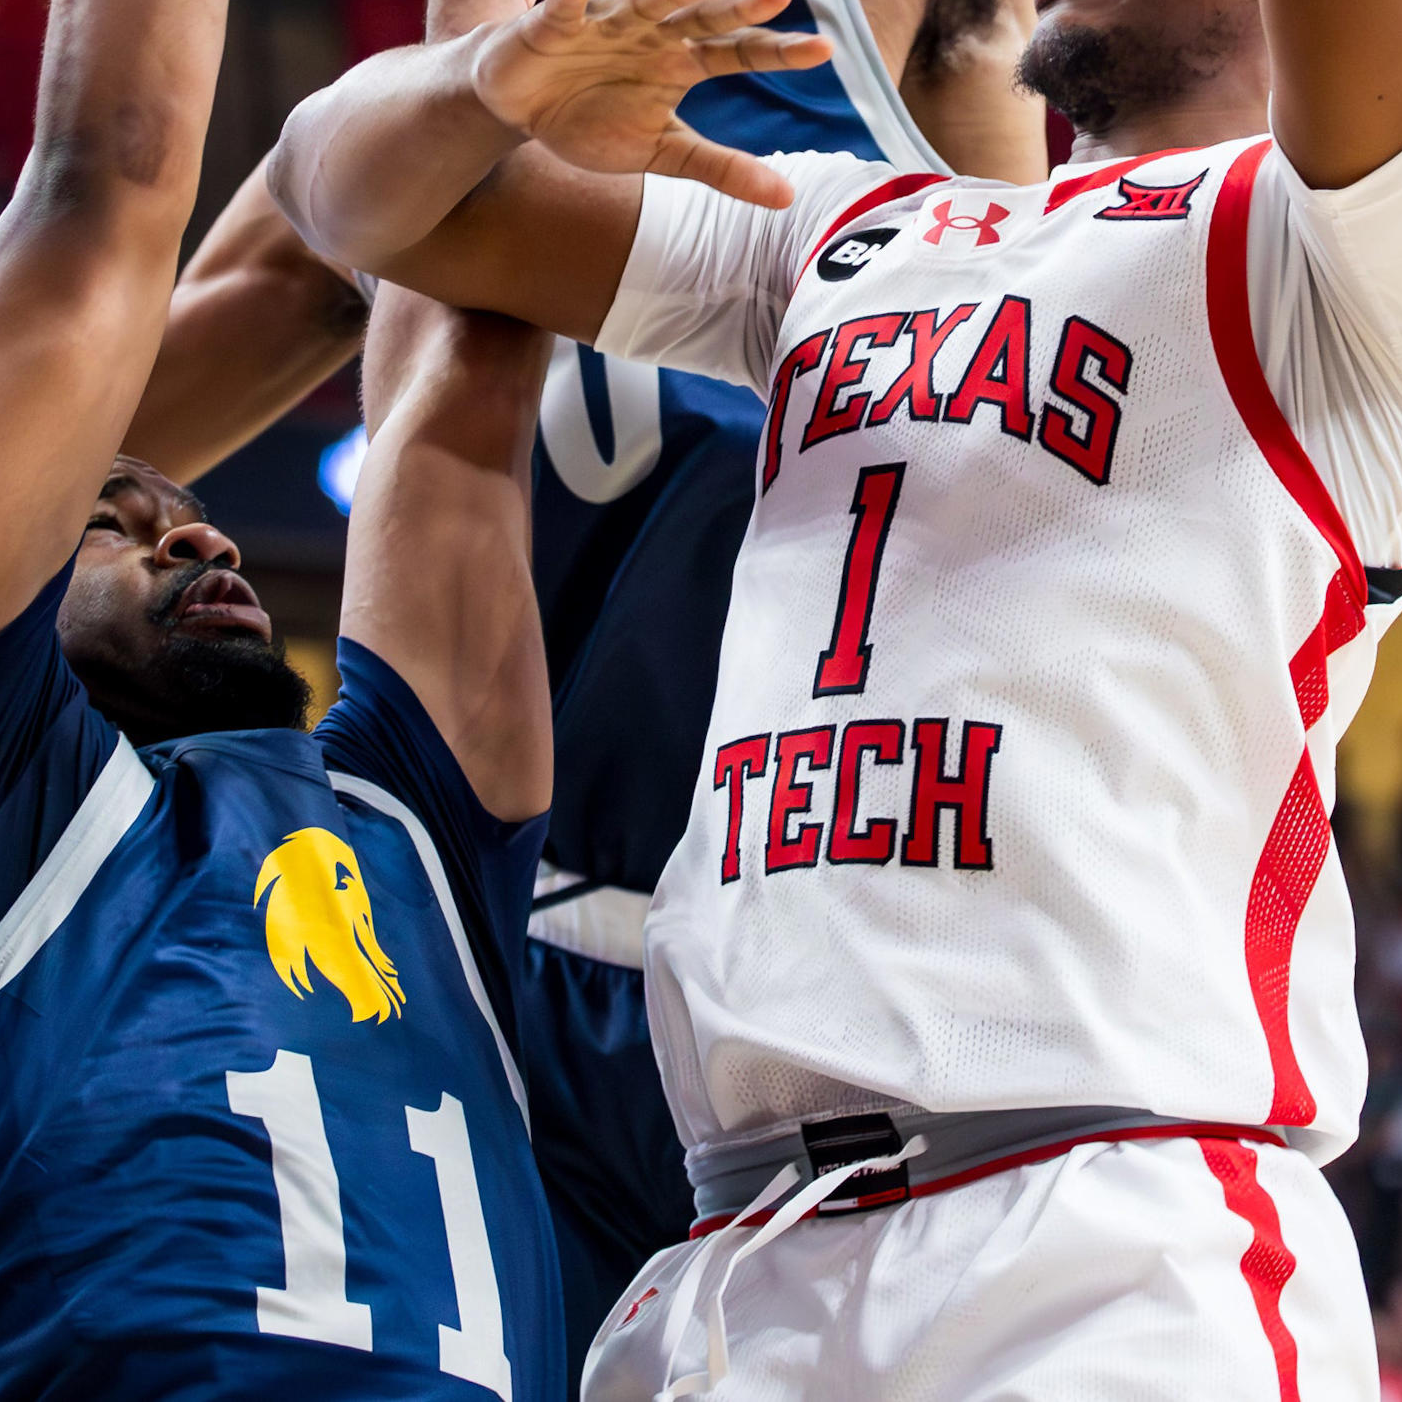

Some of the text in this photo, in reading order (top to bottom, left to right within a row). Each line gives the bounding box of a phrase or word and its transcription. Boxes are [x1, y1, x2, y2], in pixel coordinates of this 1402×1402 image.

[761, 294, 1133, 496] TEXAS
[813, 461, 907, 696] 1
[713, 718, 1003, 885] TECH
[224, 1048, 513, 1401] 11
